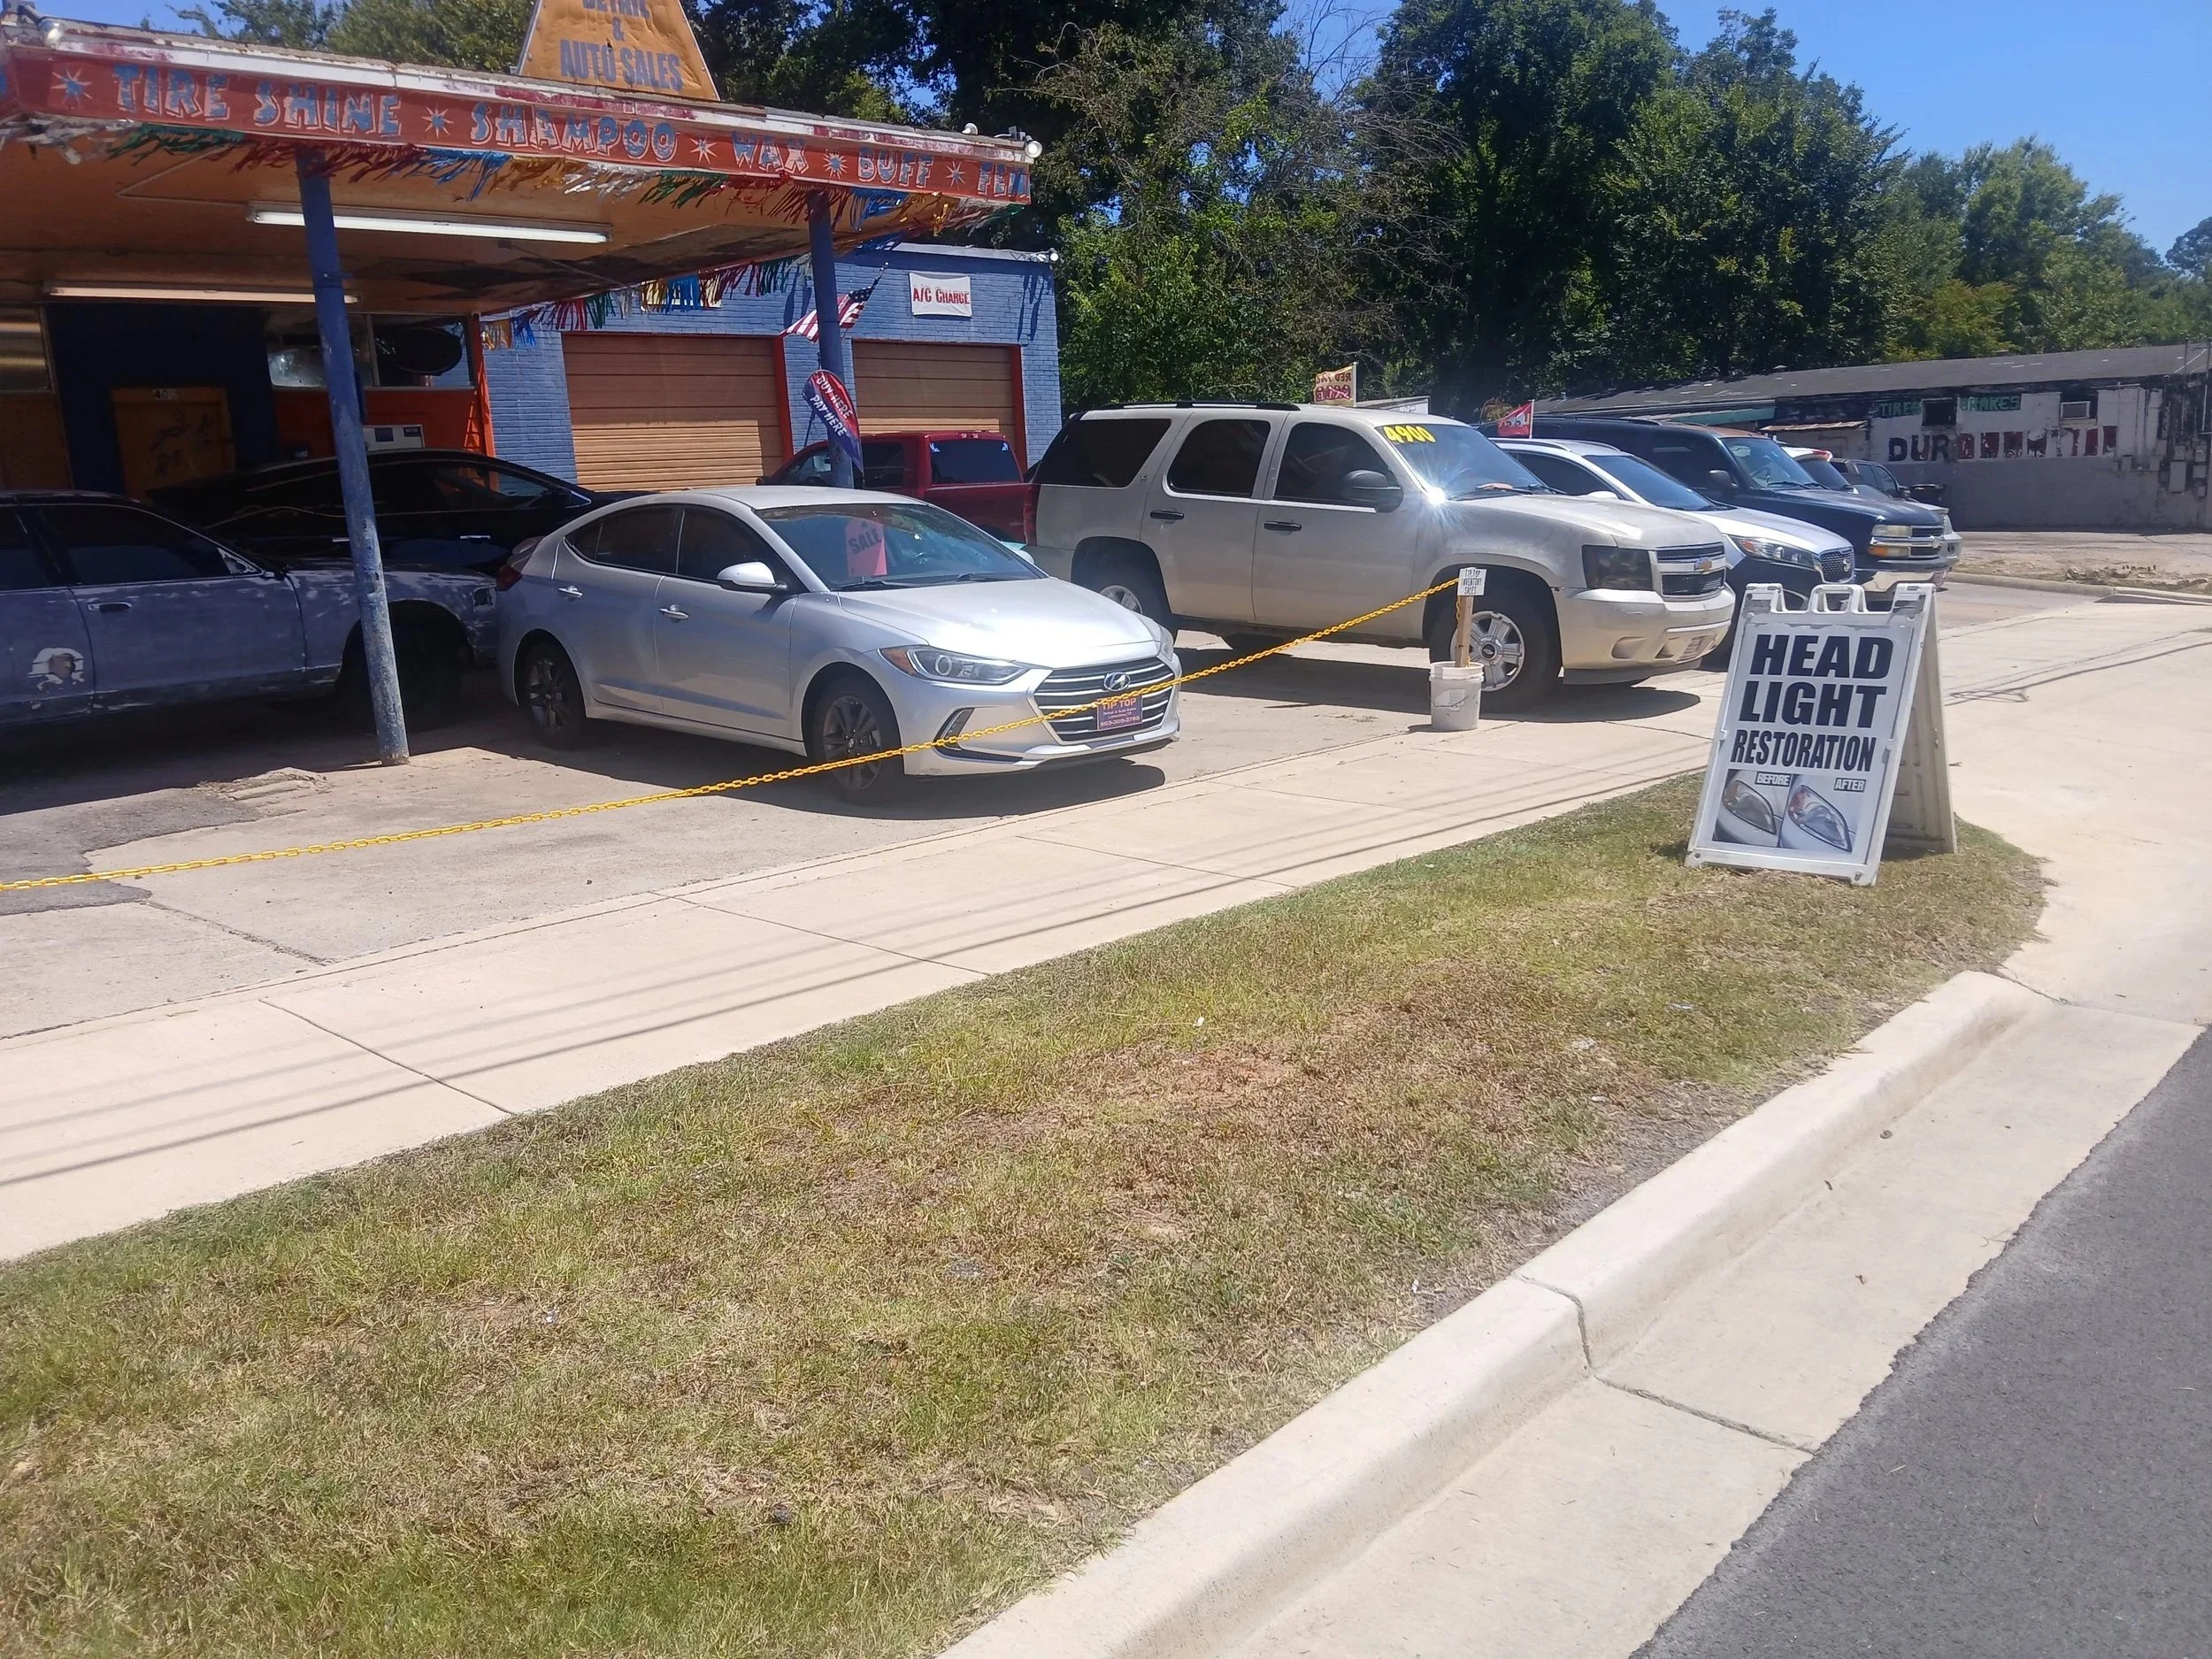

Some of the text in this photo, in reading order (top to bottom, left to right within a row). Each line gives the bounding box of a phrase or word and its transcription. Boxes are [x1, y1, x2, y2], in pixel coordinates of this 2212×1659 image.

[612, 17, 624, 42] &
[559, 39, 683, 91] AUTO SALES
[112, 64, 229, 121] TIRE
[252, 80, 401, 136] SHINE
[470, 102, 680, 163] SHAMPOO
[732, 131, 809, 174] WAX
[857, 146, 934, 188] BUFF
[912, 287, 971, 304] A/C CHARGE
[1383, 426, 1436, 443] 4900
[849, 528, 882, 555] SALE
[1749, 634, 1894, 680] HEAD
[1119, 698, 1137, 707] TOP
[1738, 680, 1888, 728] LIGHT
[1729, 729, 1877, 772] RESTORATION
[1756, 772, 1865, 791] BEFORE AFTER
